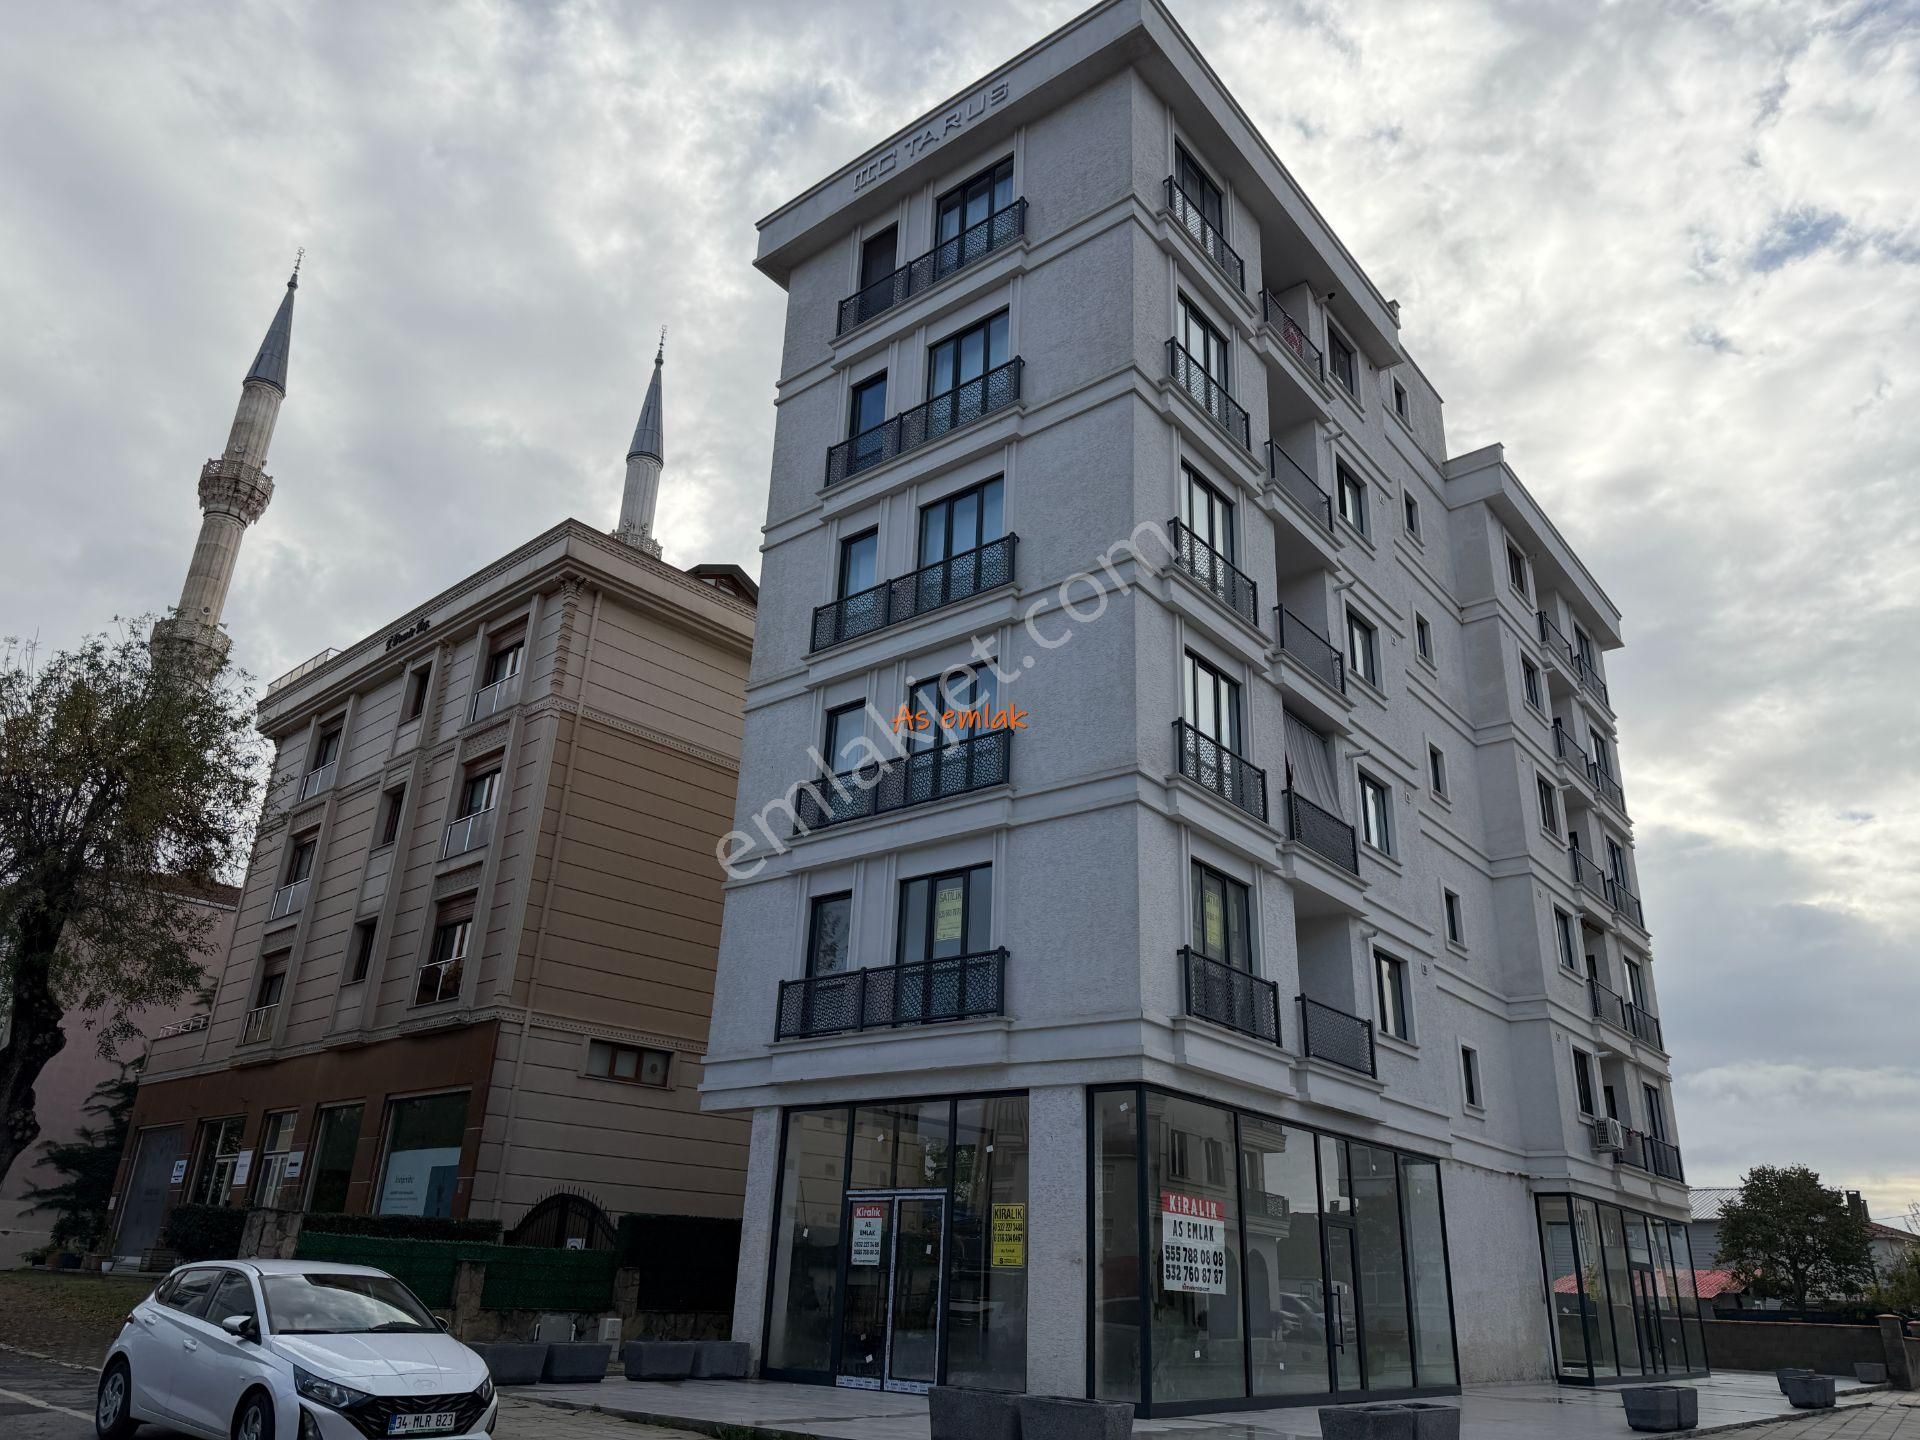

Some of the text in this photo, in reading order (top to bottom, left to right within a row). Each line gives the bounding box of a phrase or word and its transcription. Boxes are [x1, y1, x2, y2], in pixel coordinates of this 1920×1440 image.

[1172, 1219, 1214, 1242] AS EMLAK
[1165, 1244, 1224, 1267] 555 788 08 08
[1165, 1264, 1224, 1285] 532 760 87 87
[396, 1415, 408, 1429] 34
[413, 1414, 432, 1429] MLR
[435, 1413, 454, 1427] 823
